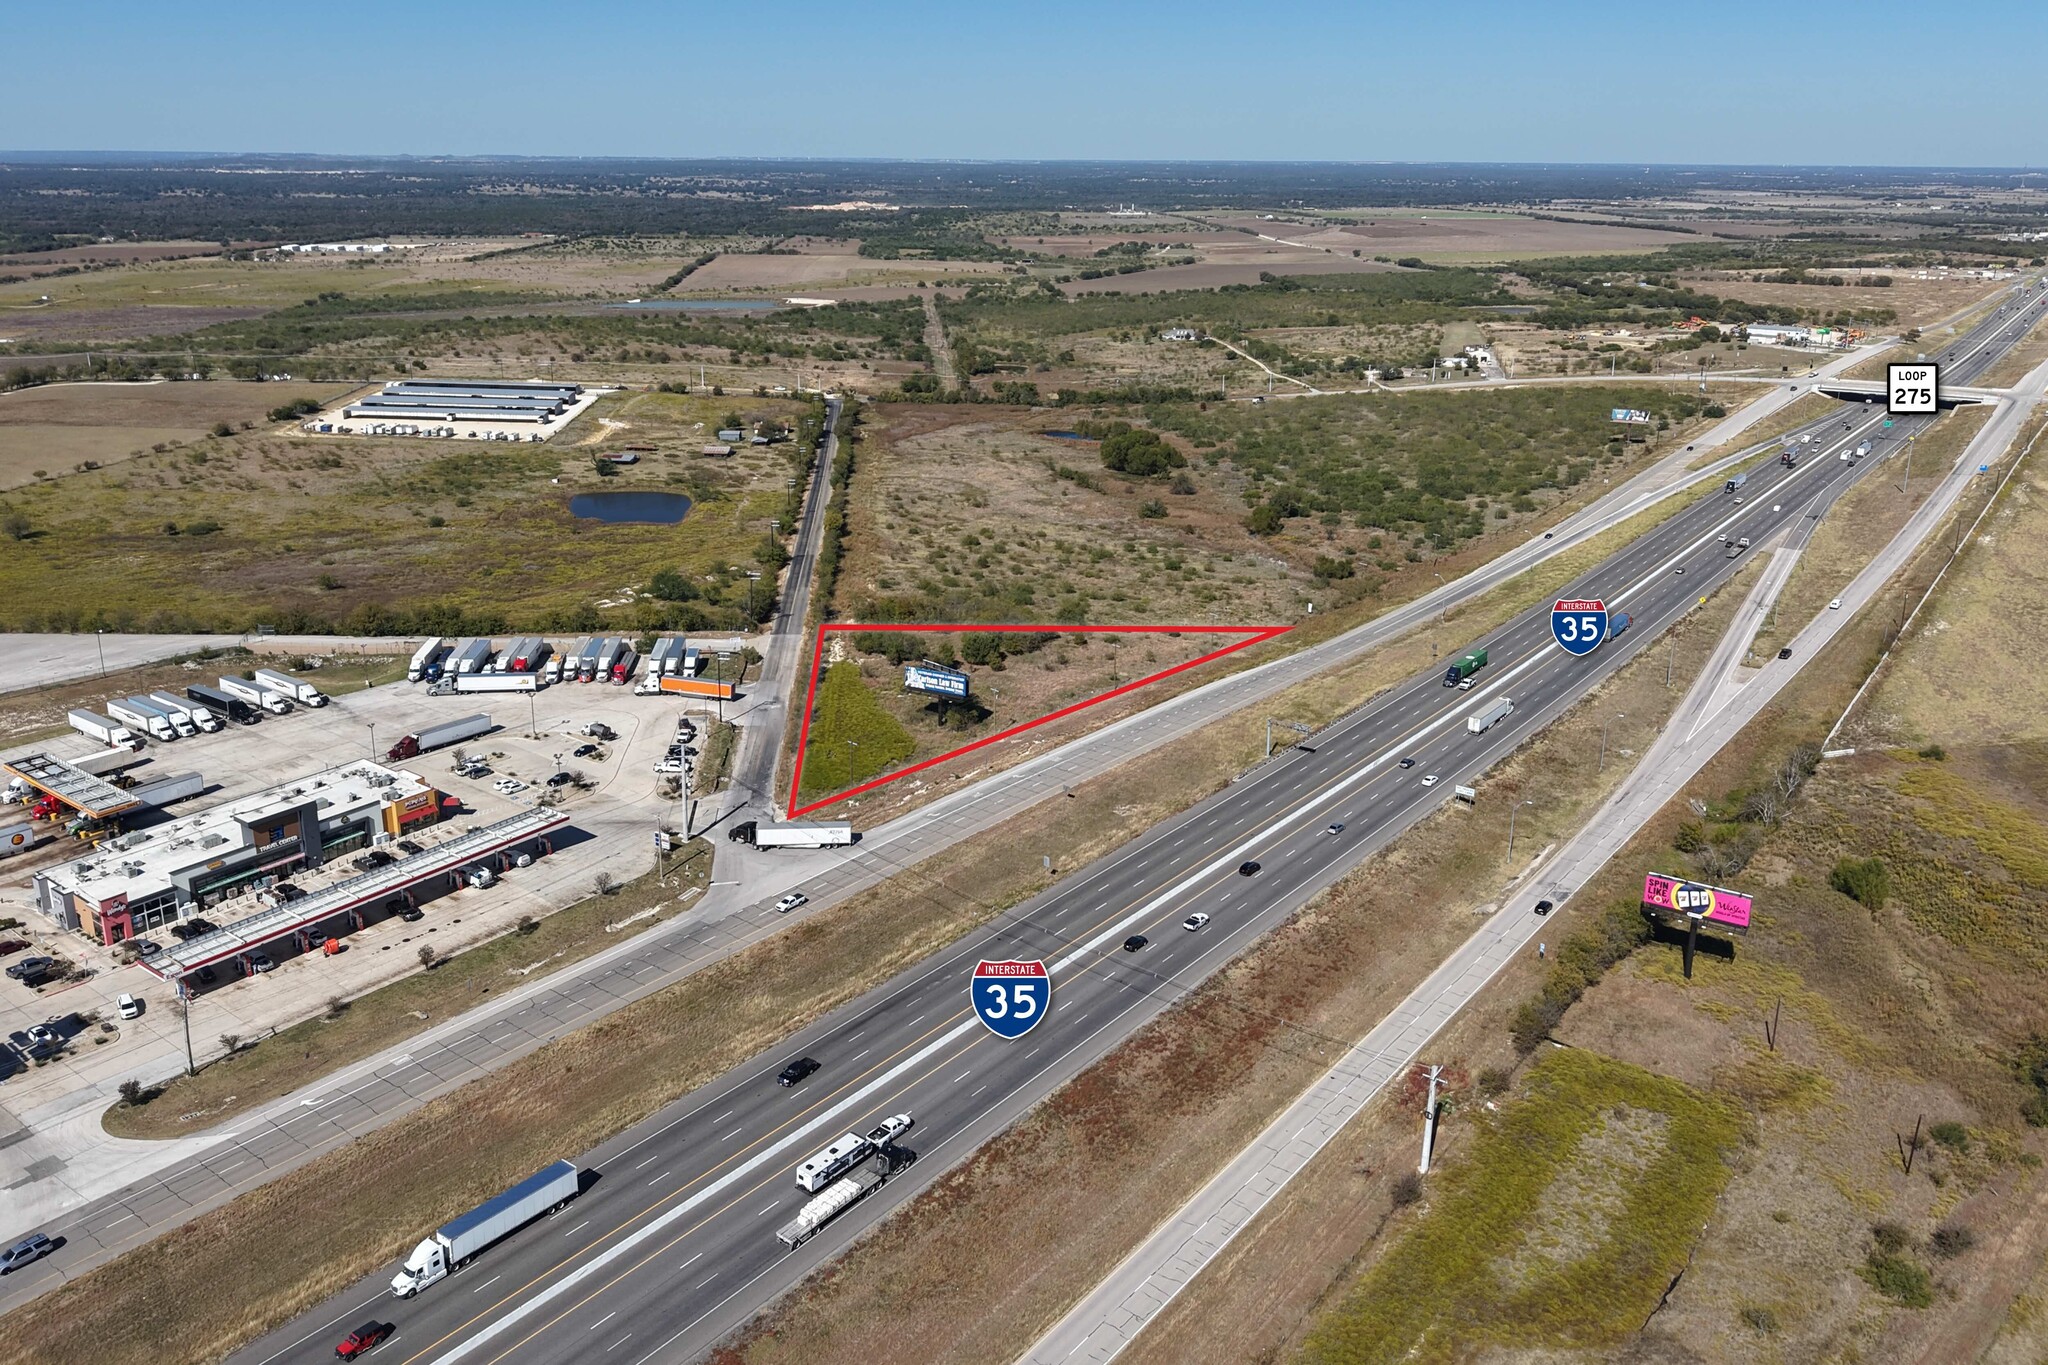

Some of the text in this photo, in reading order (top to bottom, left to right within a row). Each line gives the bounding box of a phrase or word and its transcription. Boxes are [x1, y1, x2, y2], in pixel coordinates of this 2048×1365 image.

[260, 835, 298, 852] TRAVEL CENTER
[1648, 878, 1669, 890] SPIN
[1648, 886, 1667, 897] LIKE
[1647, 894, 1670, 904] WOW
